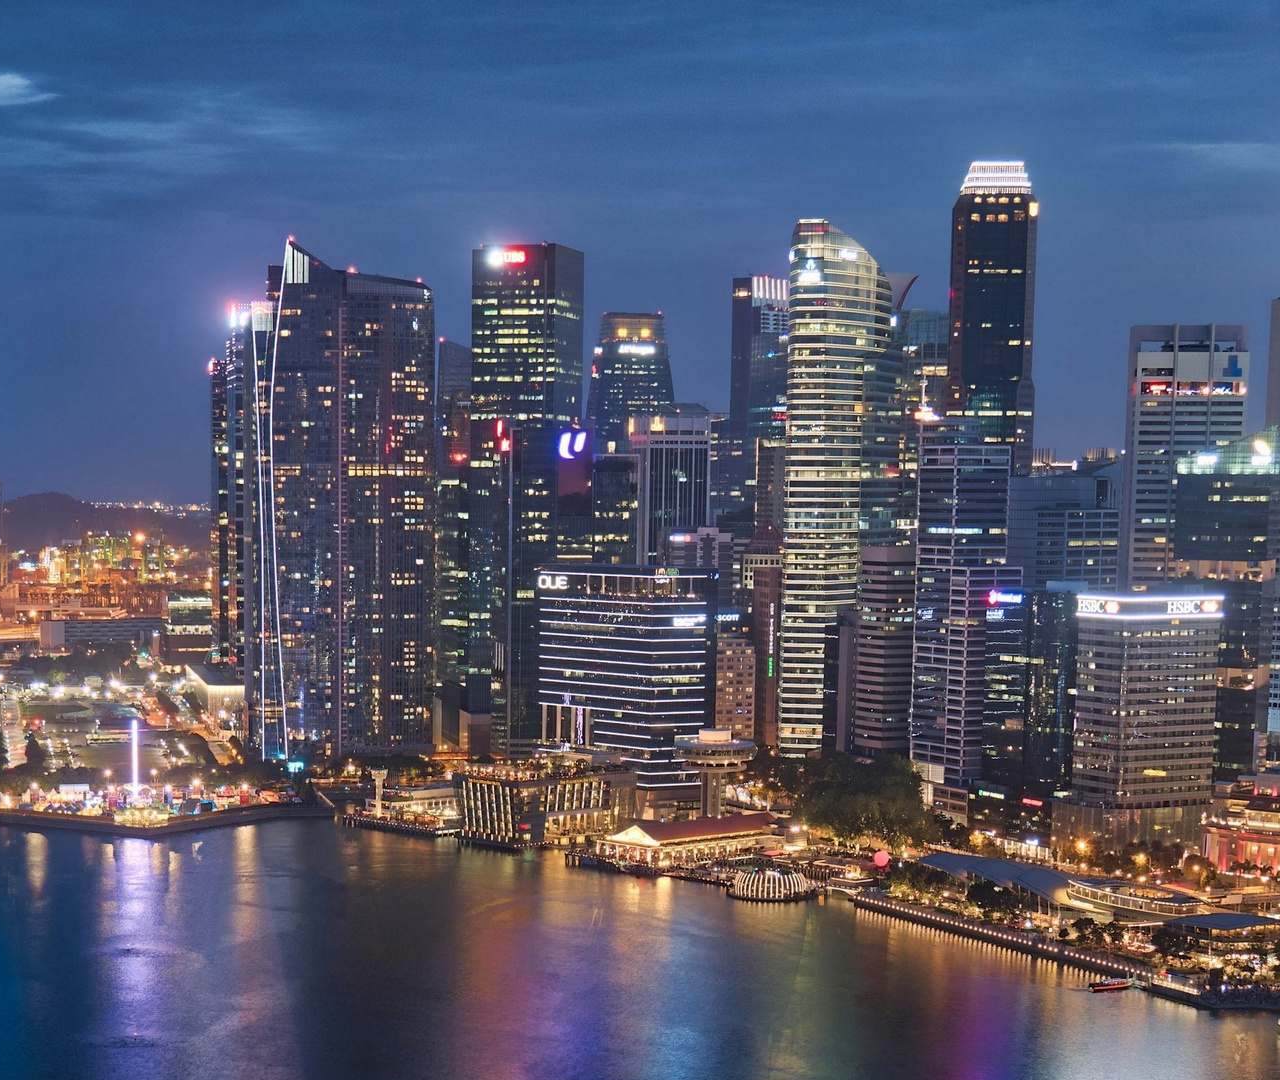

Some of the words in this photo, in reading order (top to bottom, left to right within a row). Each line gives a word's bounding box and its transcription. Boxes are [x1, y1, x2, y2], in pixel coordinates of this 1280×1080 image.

[538, 575, 569, 589] OUE
[1077, 599, 1105, 612] HSBC
[1167, 601, 1200, 613] HSBC
